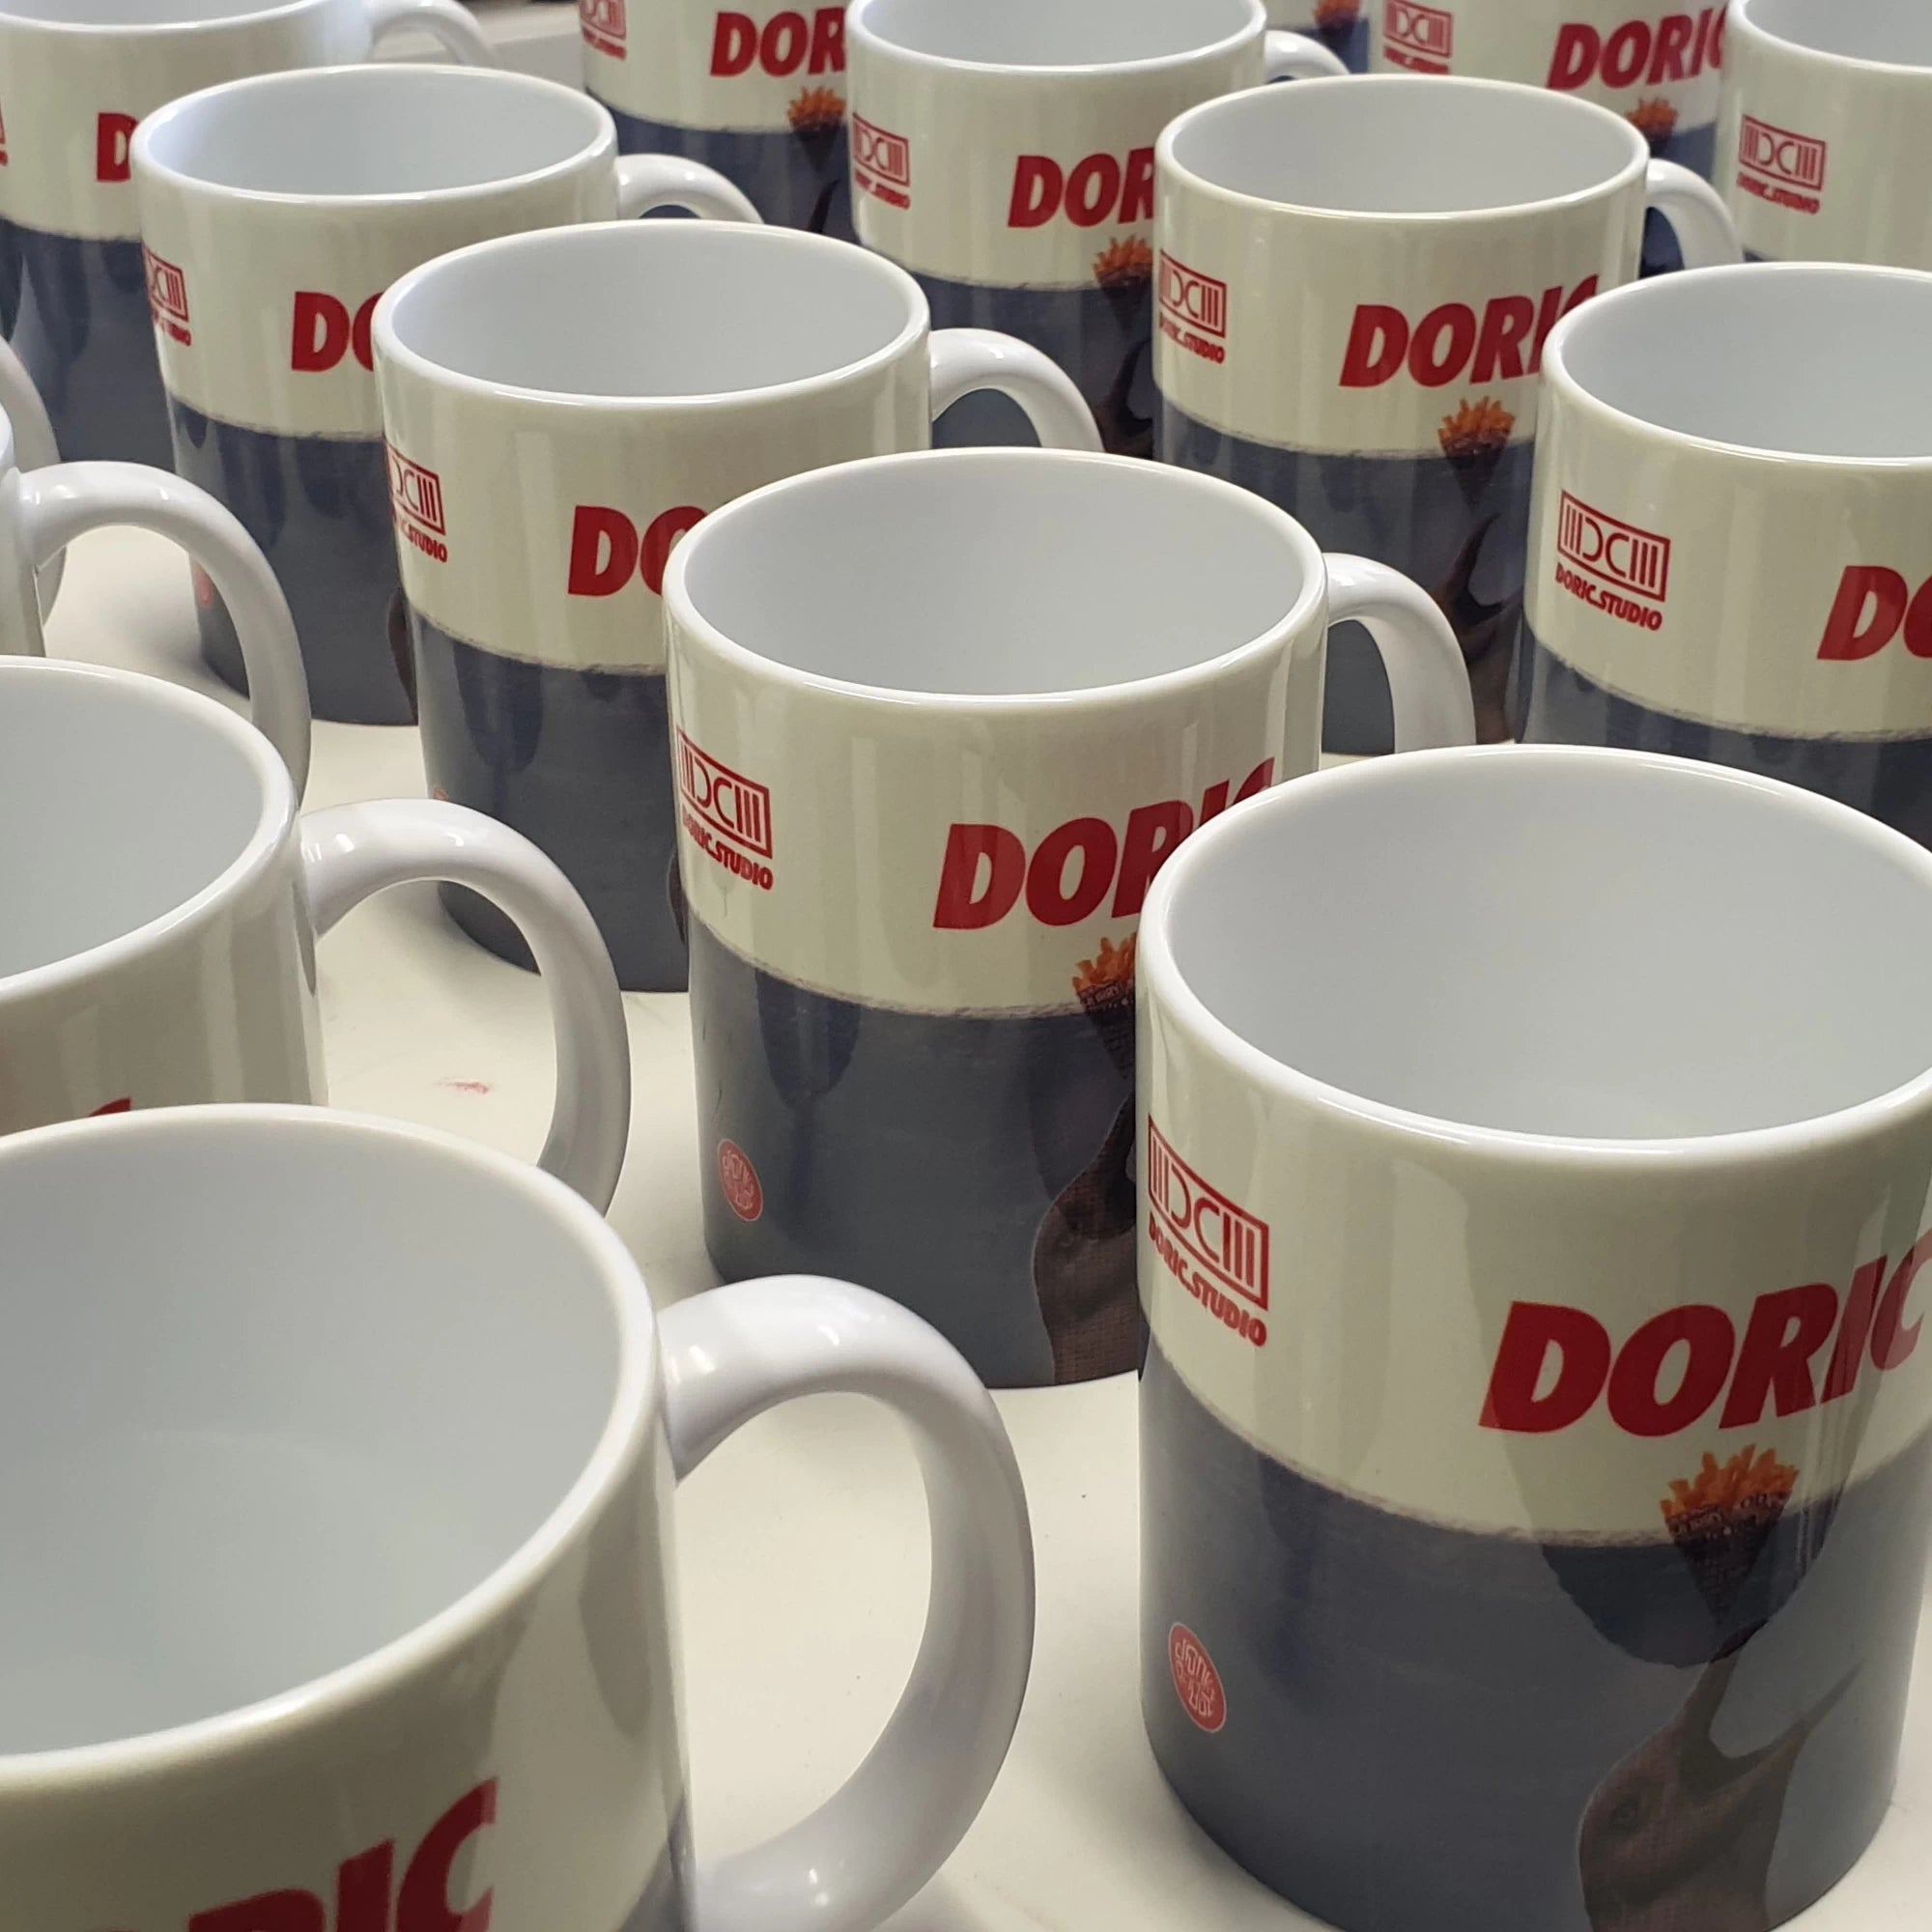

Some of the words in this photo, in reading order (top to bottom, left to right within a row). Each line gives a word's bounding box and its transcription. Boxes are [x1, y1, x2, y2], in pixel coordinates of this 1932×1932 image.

[710, 6, 846, 78] DOR
[1007, 146, 1154, 229] DOR
[1478, 1226, 1932, 1438] DORIC
